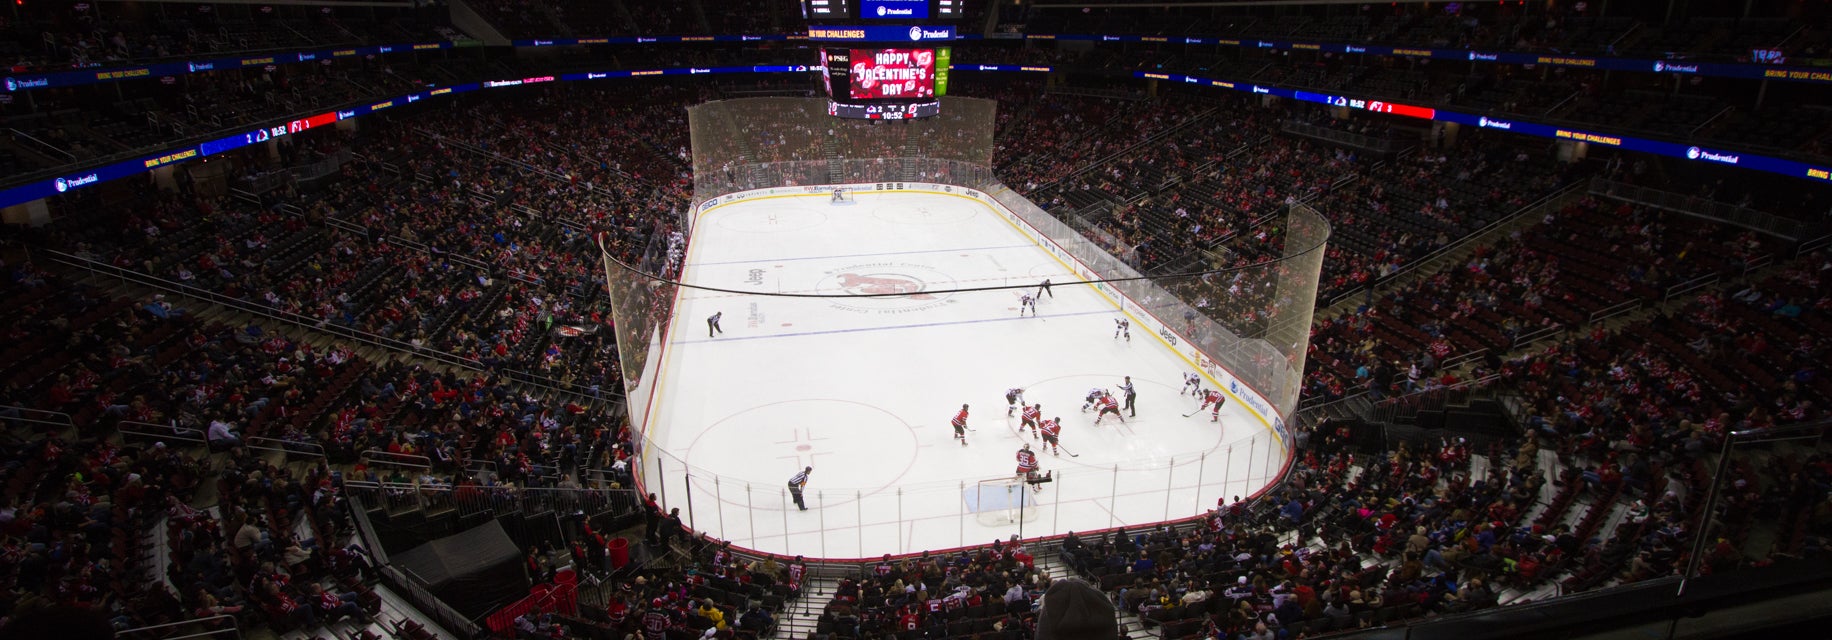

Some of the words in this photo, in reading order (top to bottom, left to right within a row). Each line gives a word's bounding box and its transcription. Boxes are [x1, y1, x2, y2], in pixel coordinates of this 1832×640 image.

[827, 30, 865, 38] CHALLENGES
[923, 30, 949, 38] Prudential
[876, 53, 910, 65] HAPPY
[859, 68, 926, 80] VALENTINE'S
[1665, 64, 1698, 73] Prudential
[1765, 69, 1786, 78] BRING
[1789, 71, 1809, 79] YOUR
[17, 77, 48, 88] Prudential
[882, 83, 902, 95] DAY
[1556, 129, 1571, 139] BRING
[1572, 132, 1586, 140] YOUR
[1587, 133, 1621, 146] CHALLENGES
[1700, 151, 1739, 164] Prudential
[1807, 168, 1829, 180] BRING
[67, 173, 98, 188] Prudential
[965, 188, 979, 198] Jeep
[744, 269, 766, 285] Jeep
[1159, 325, 1177, 346] Jeep
[1239, 387, 1268, 417] Prudential
[1019, 455, 1029, 465] 35
